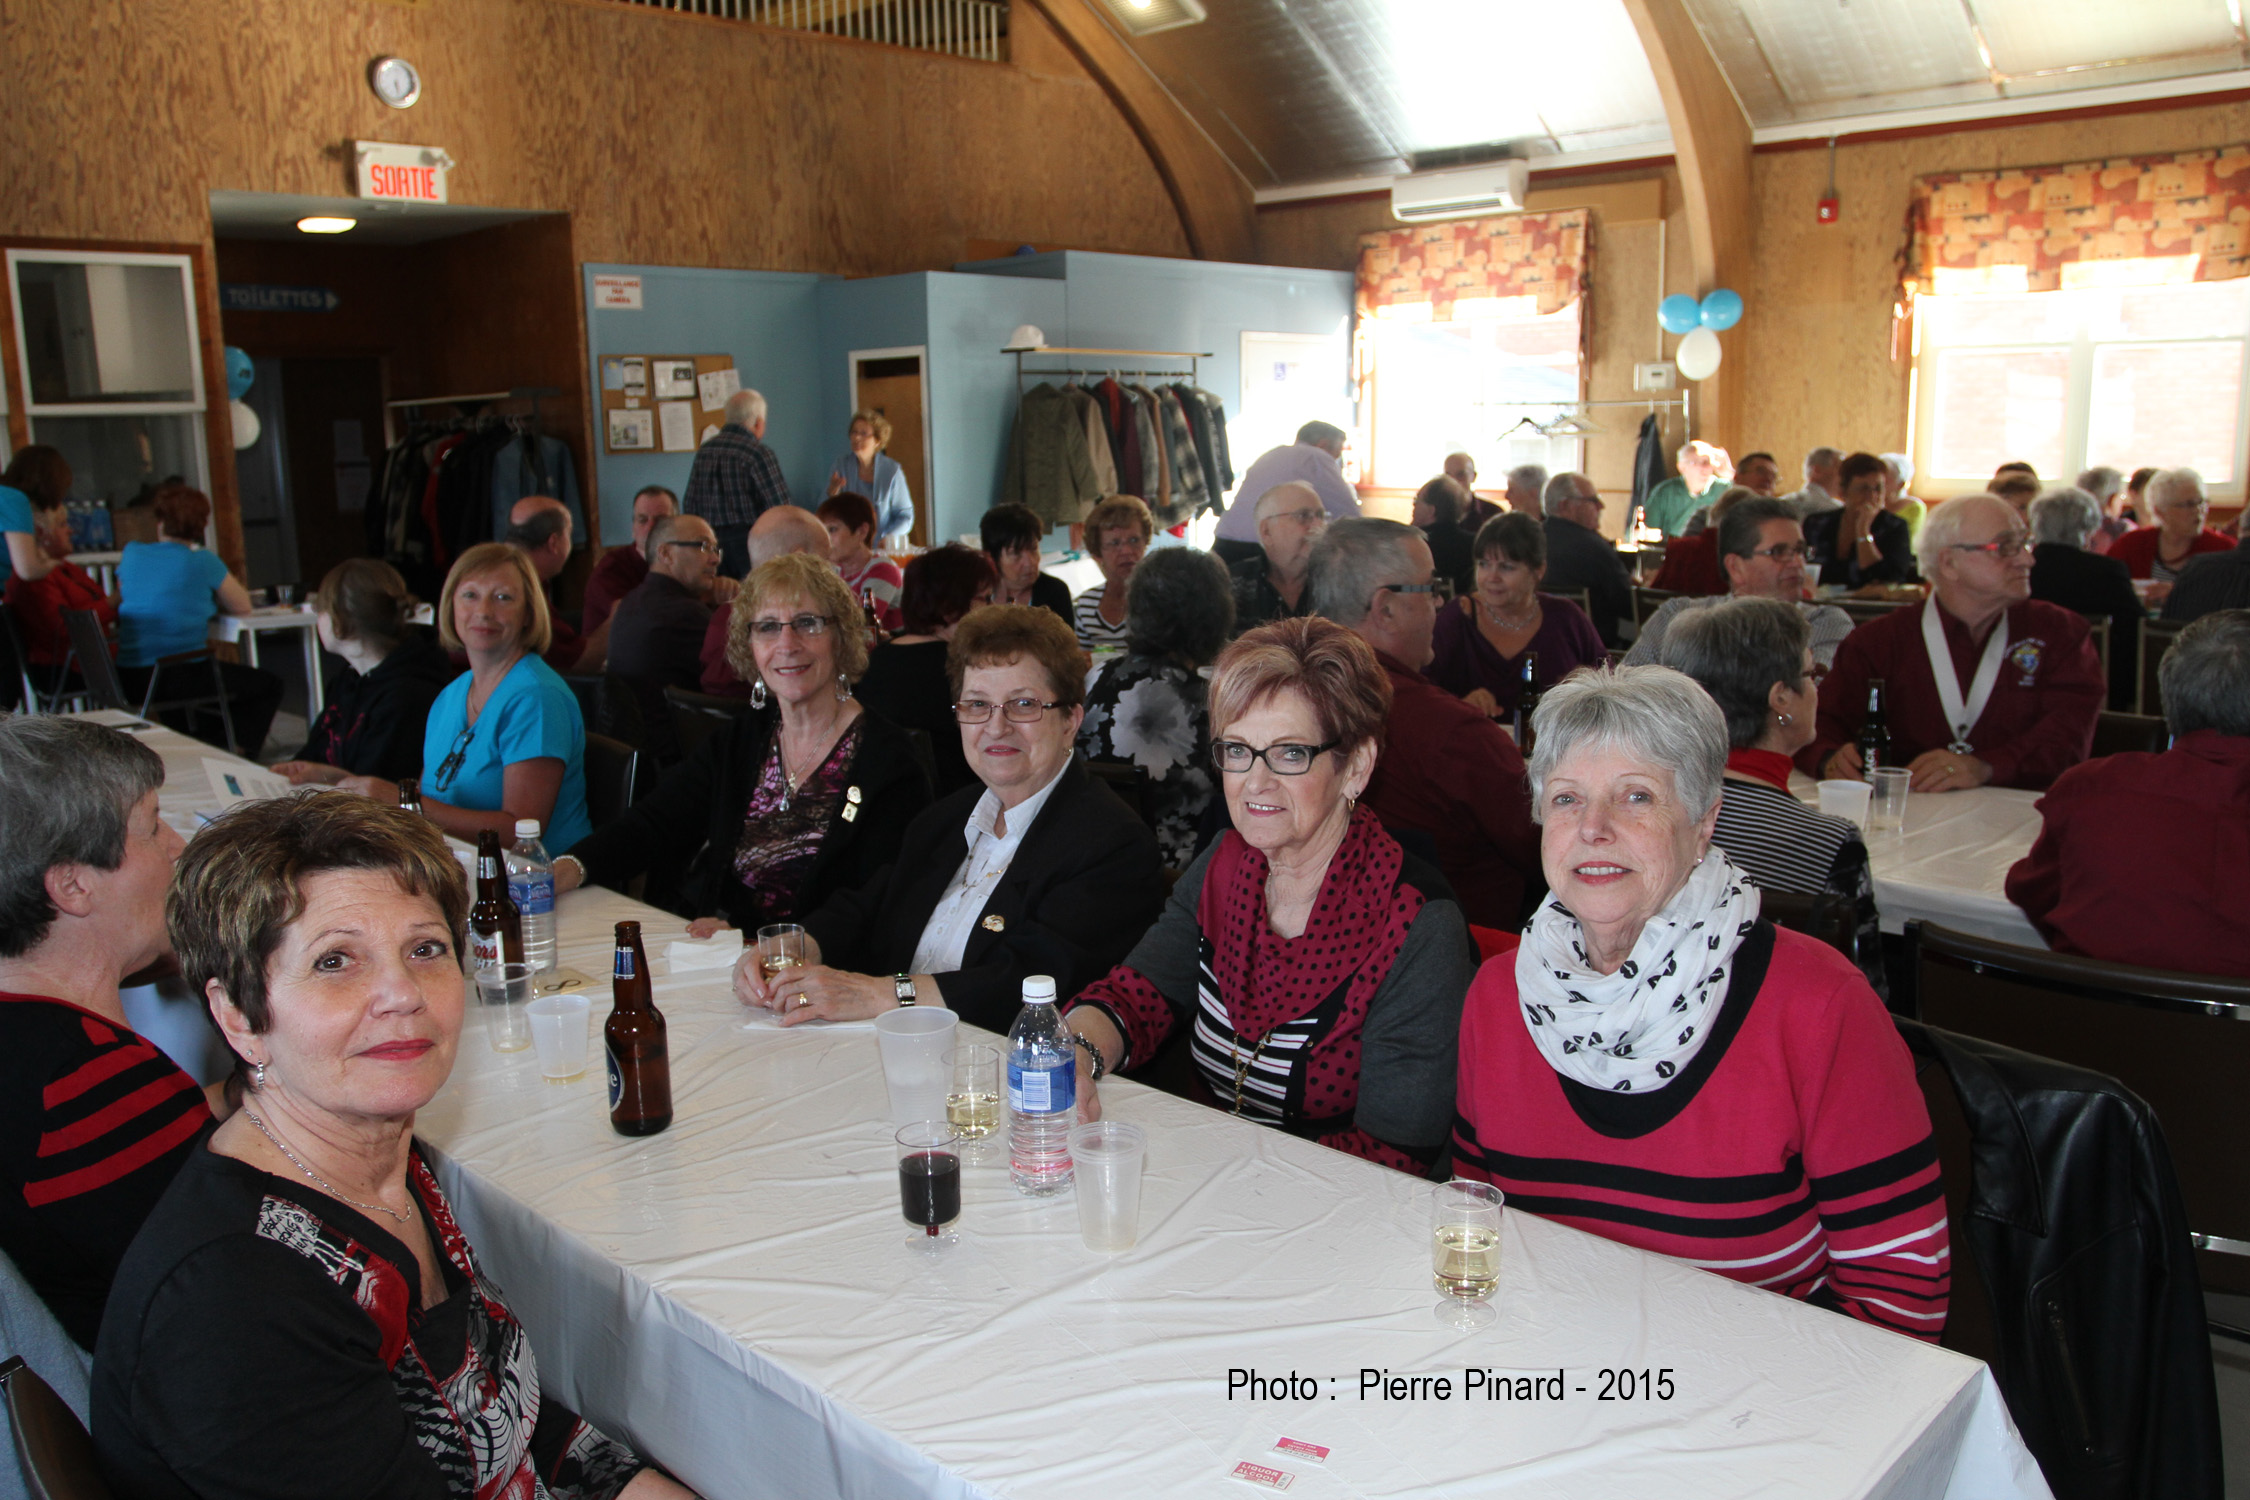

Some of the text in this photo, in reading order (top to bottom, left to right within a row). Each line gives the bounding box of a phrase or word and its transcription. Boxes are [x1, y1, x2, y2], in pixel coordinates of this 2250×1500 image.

[370, 163, 438, 200] SORTIE
[1237, 1468, 1275, 1482] ALCOOL
[1241, 1463, 1279, 1477] LIQUOR
